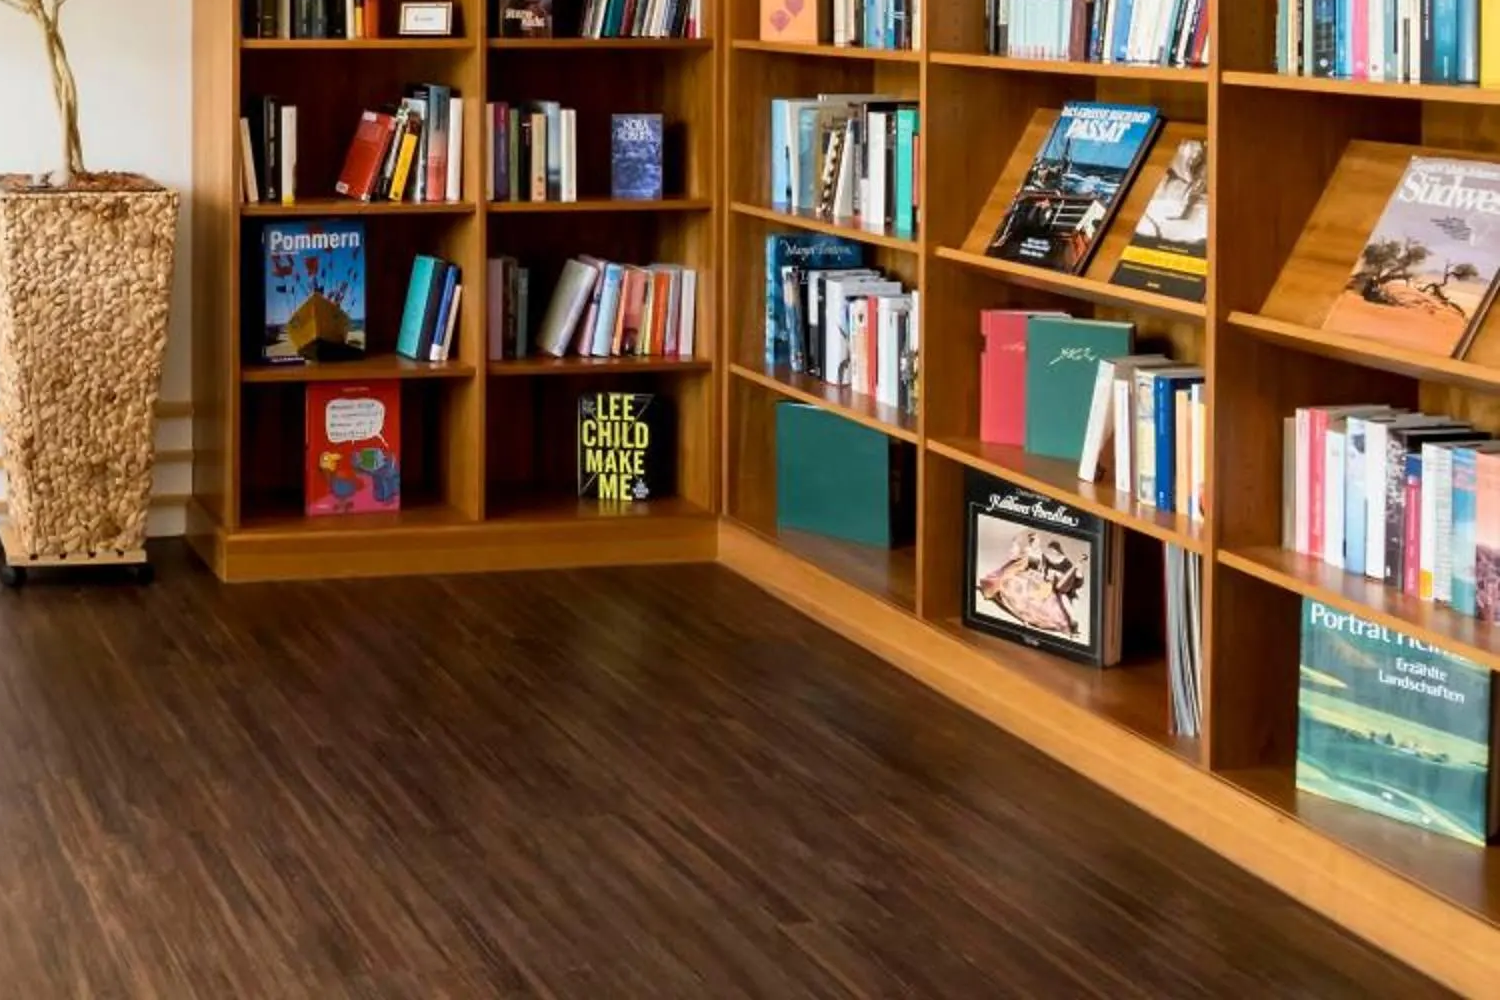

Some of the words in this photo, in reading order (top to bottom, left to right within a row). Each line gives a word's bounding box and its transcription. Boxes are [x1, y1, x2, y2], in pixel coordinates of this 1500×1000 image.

[1064, 118, 1132, 142] PASSAT
[270, 231, 360, 250] Pommern
[597, 393, 636, 421] LEE
[582, 420, 649, 449] CHILD
[586, 449, 645, 474] MAKE
[599, 473, 633, 500] ME
[1395, 656, 1449, 682] Erzählte
[1378, 668, 1466, 704] Landschaften
